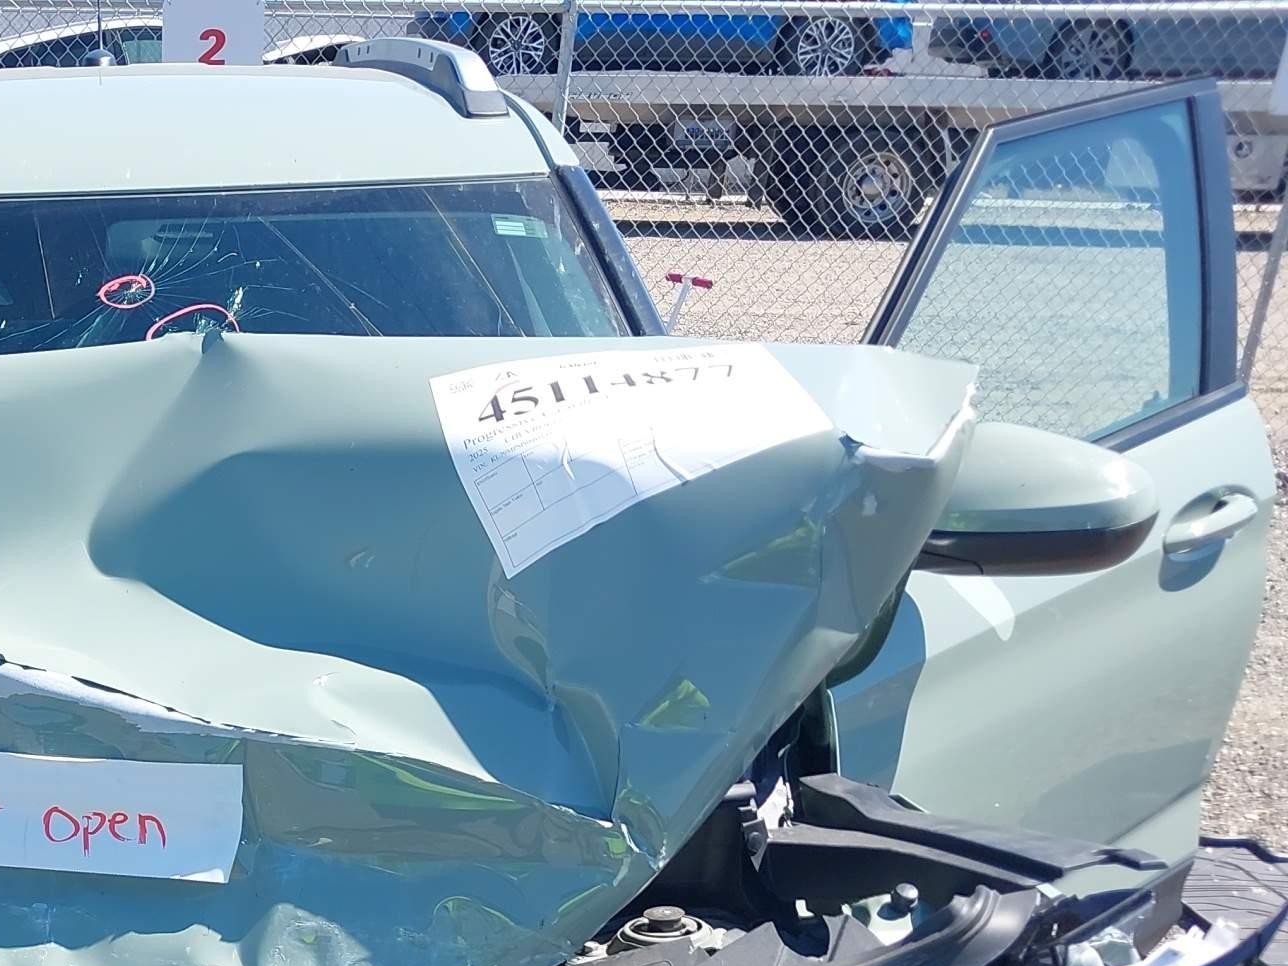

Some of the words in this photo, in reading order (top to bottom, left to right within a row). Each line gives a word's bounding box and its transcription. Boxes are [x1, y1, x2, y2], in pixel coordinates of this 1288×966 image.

[198, 27, 227, 65] 2
[477, 363, 734, 423] 45114877
[468, 447, 489, 462] 2025
